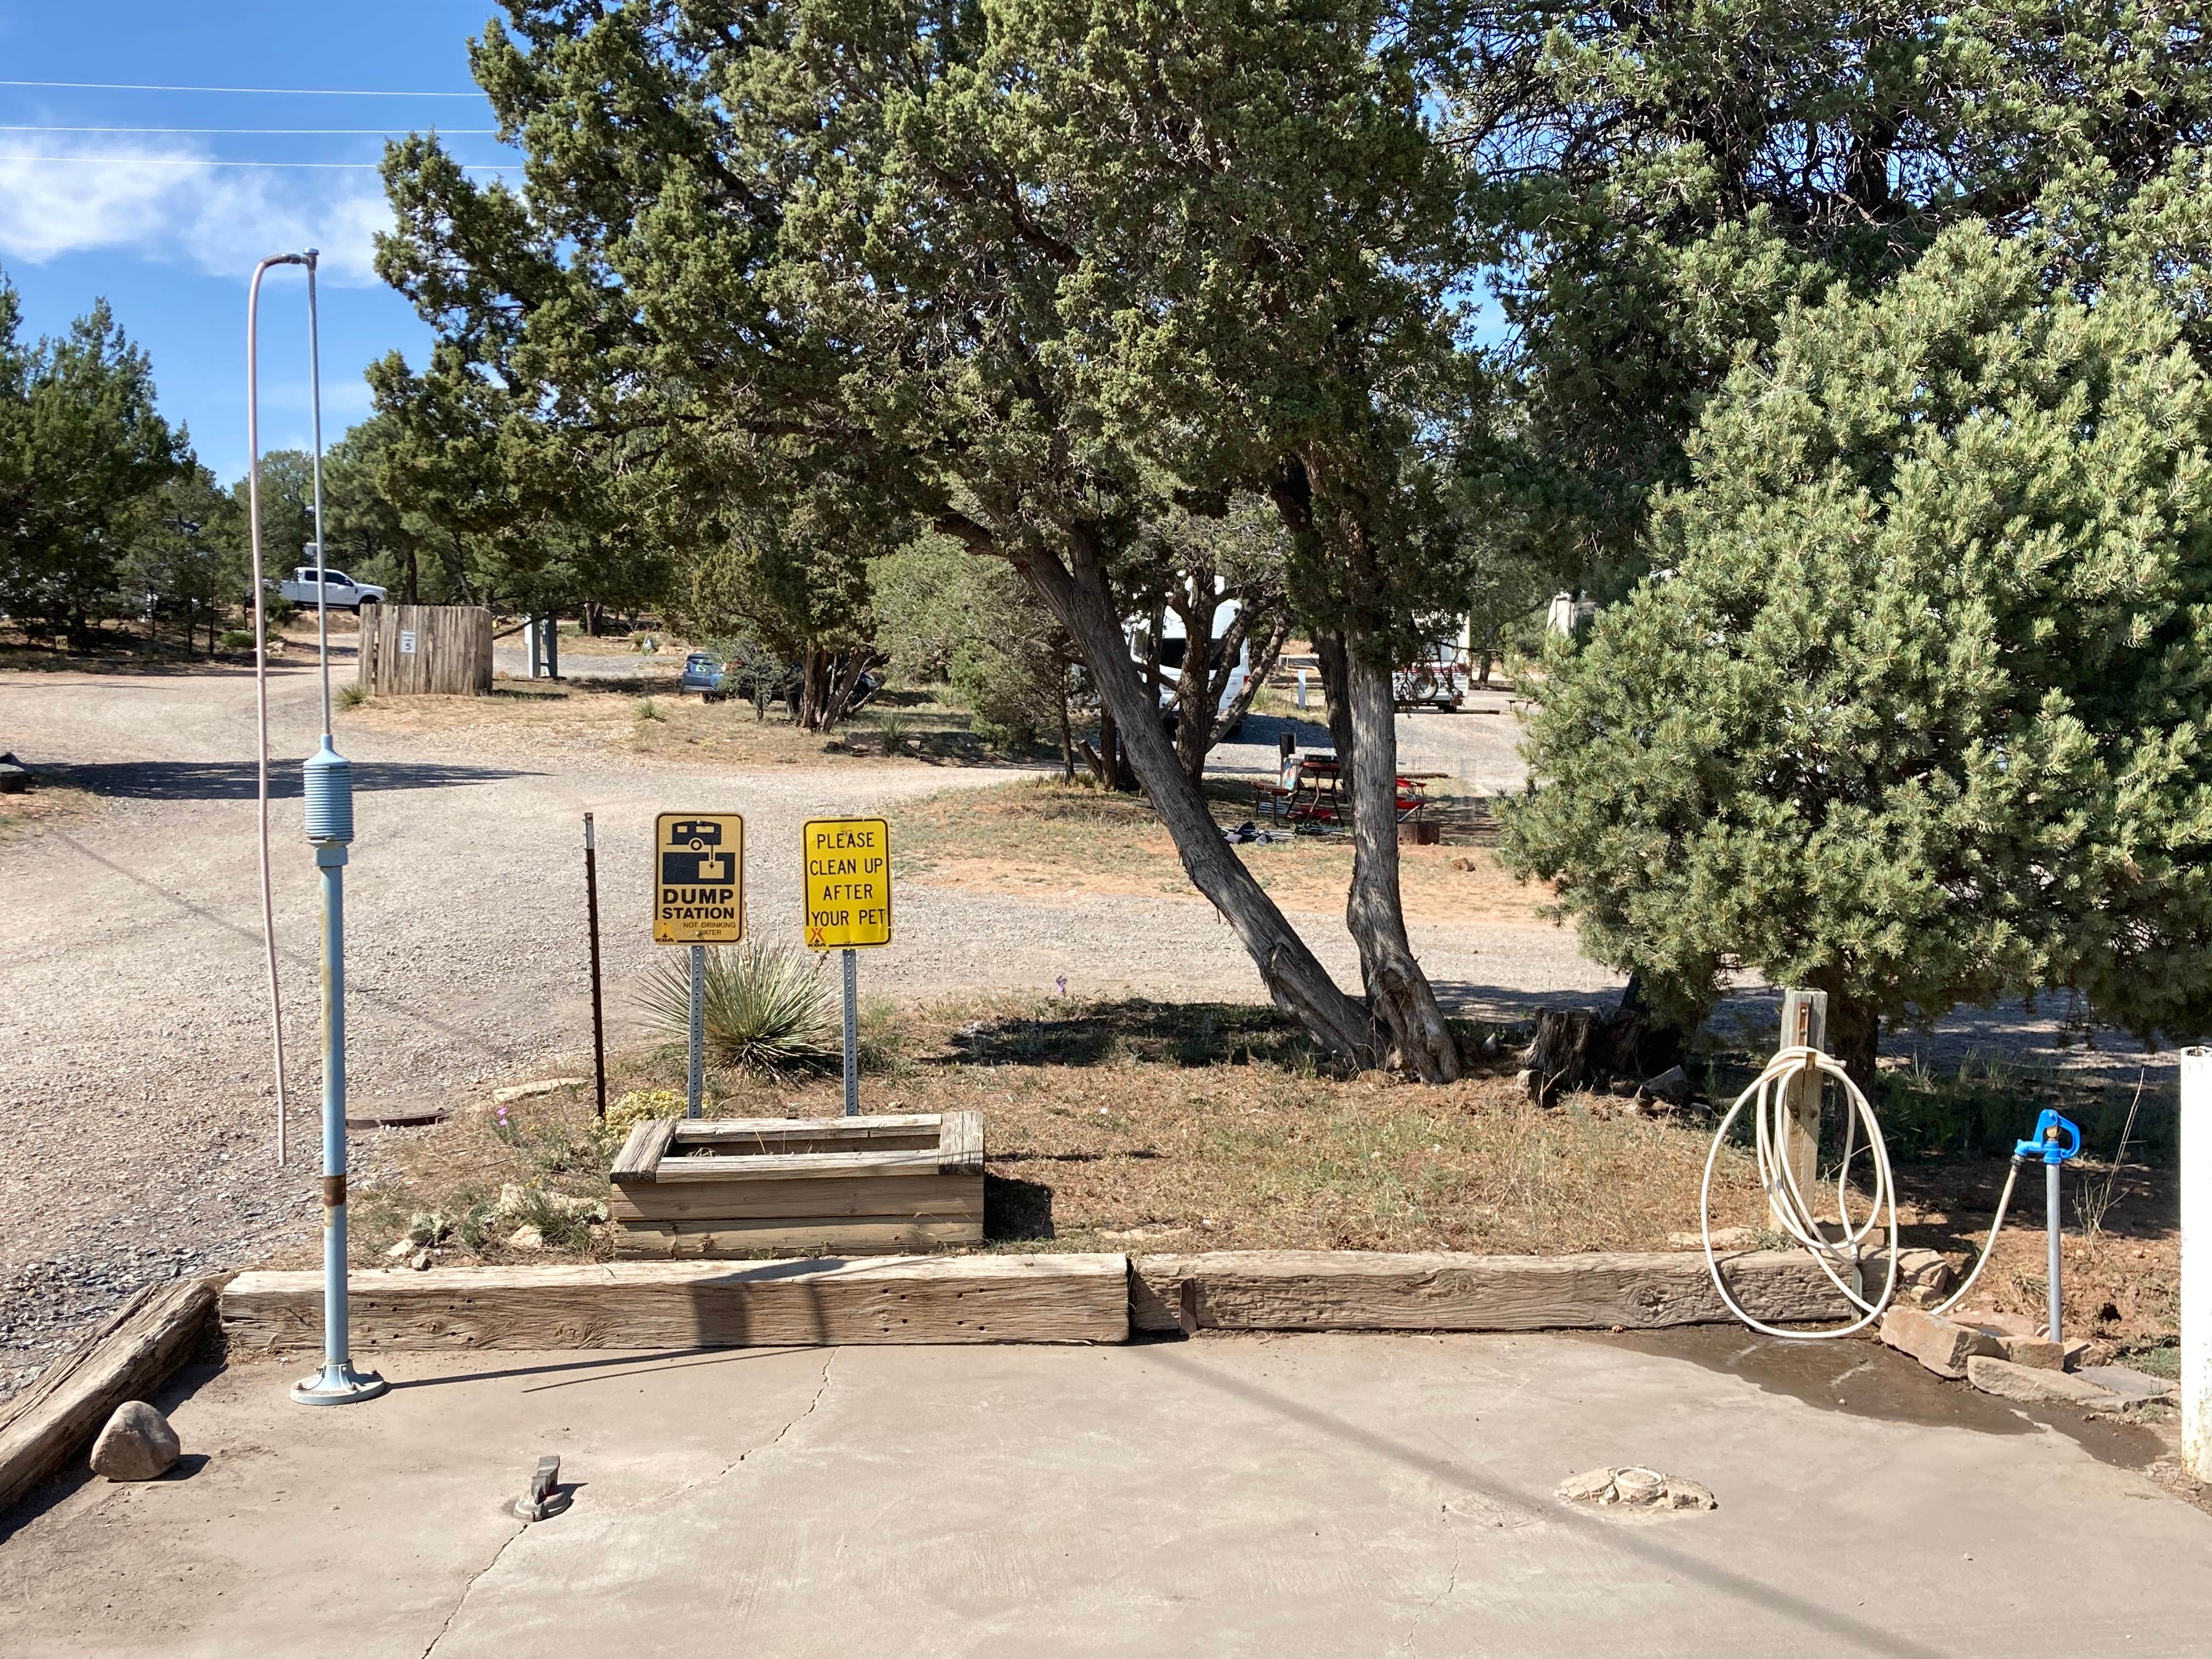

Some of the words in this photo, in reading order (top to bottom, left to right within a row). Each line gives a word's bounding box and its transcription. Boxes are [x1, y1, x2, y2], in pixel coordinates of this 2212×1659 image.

[817, 832, 874, 849] PLEASE
[810, 859, 856, 876] CLEAN
[865, 858, 883, 873] UP
[663, 889, 733, 904] DUMP
[823, 884, 872, 901] AFTER
[662, 907, 734, 919] STATION
[811, 910, 849, 927] YOUR
[859, 909, 885, 924] PET
